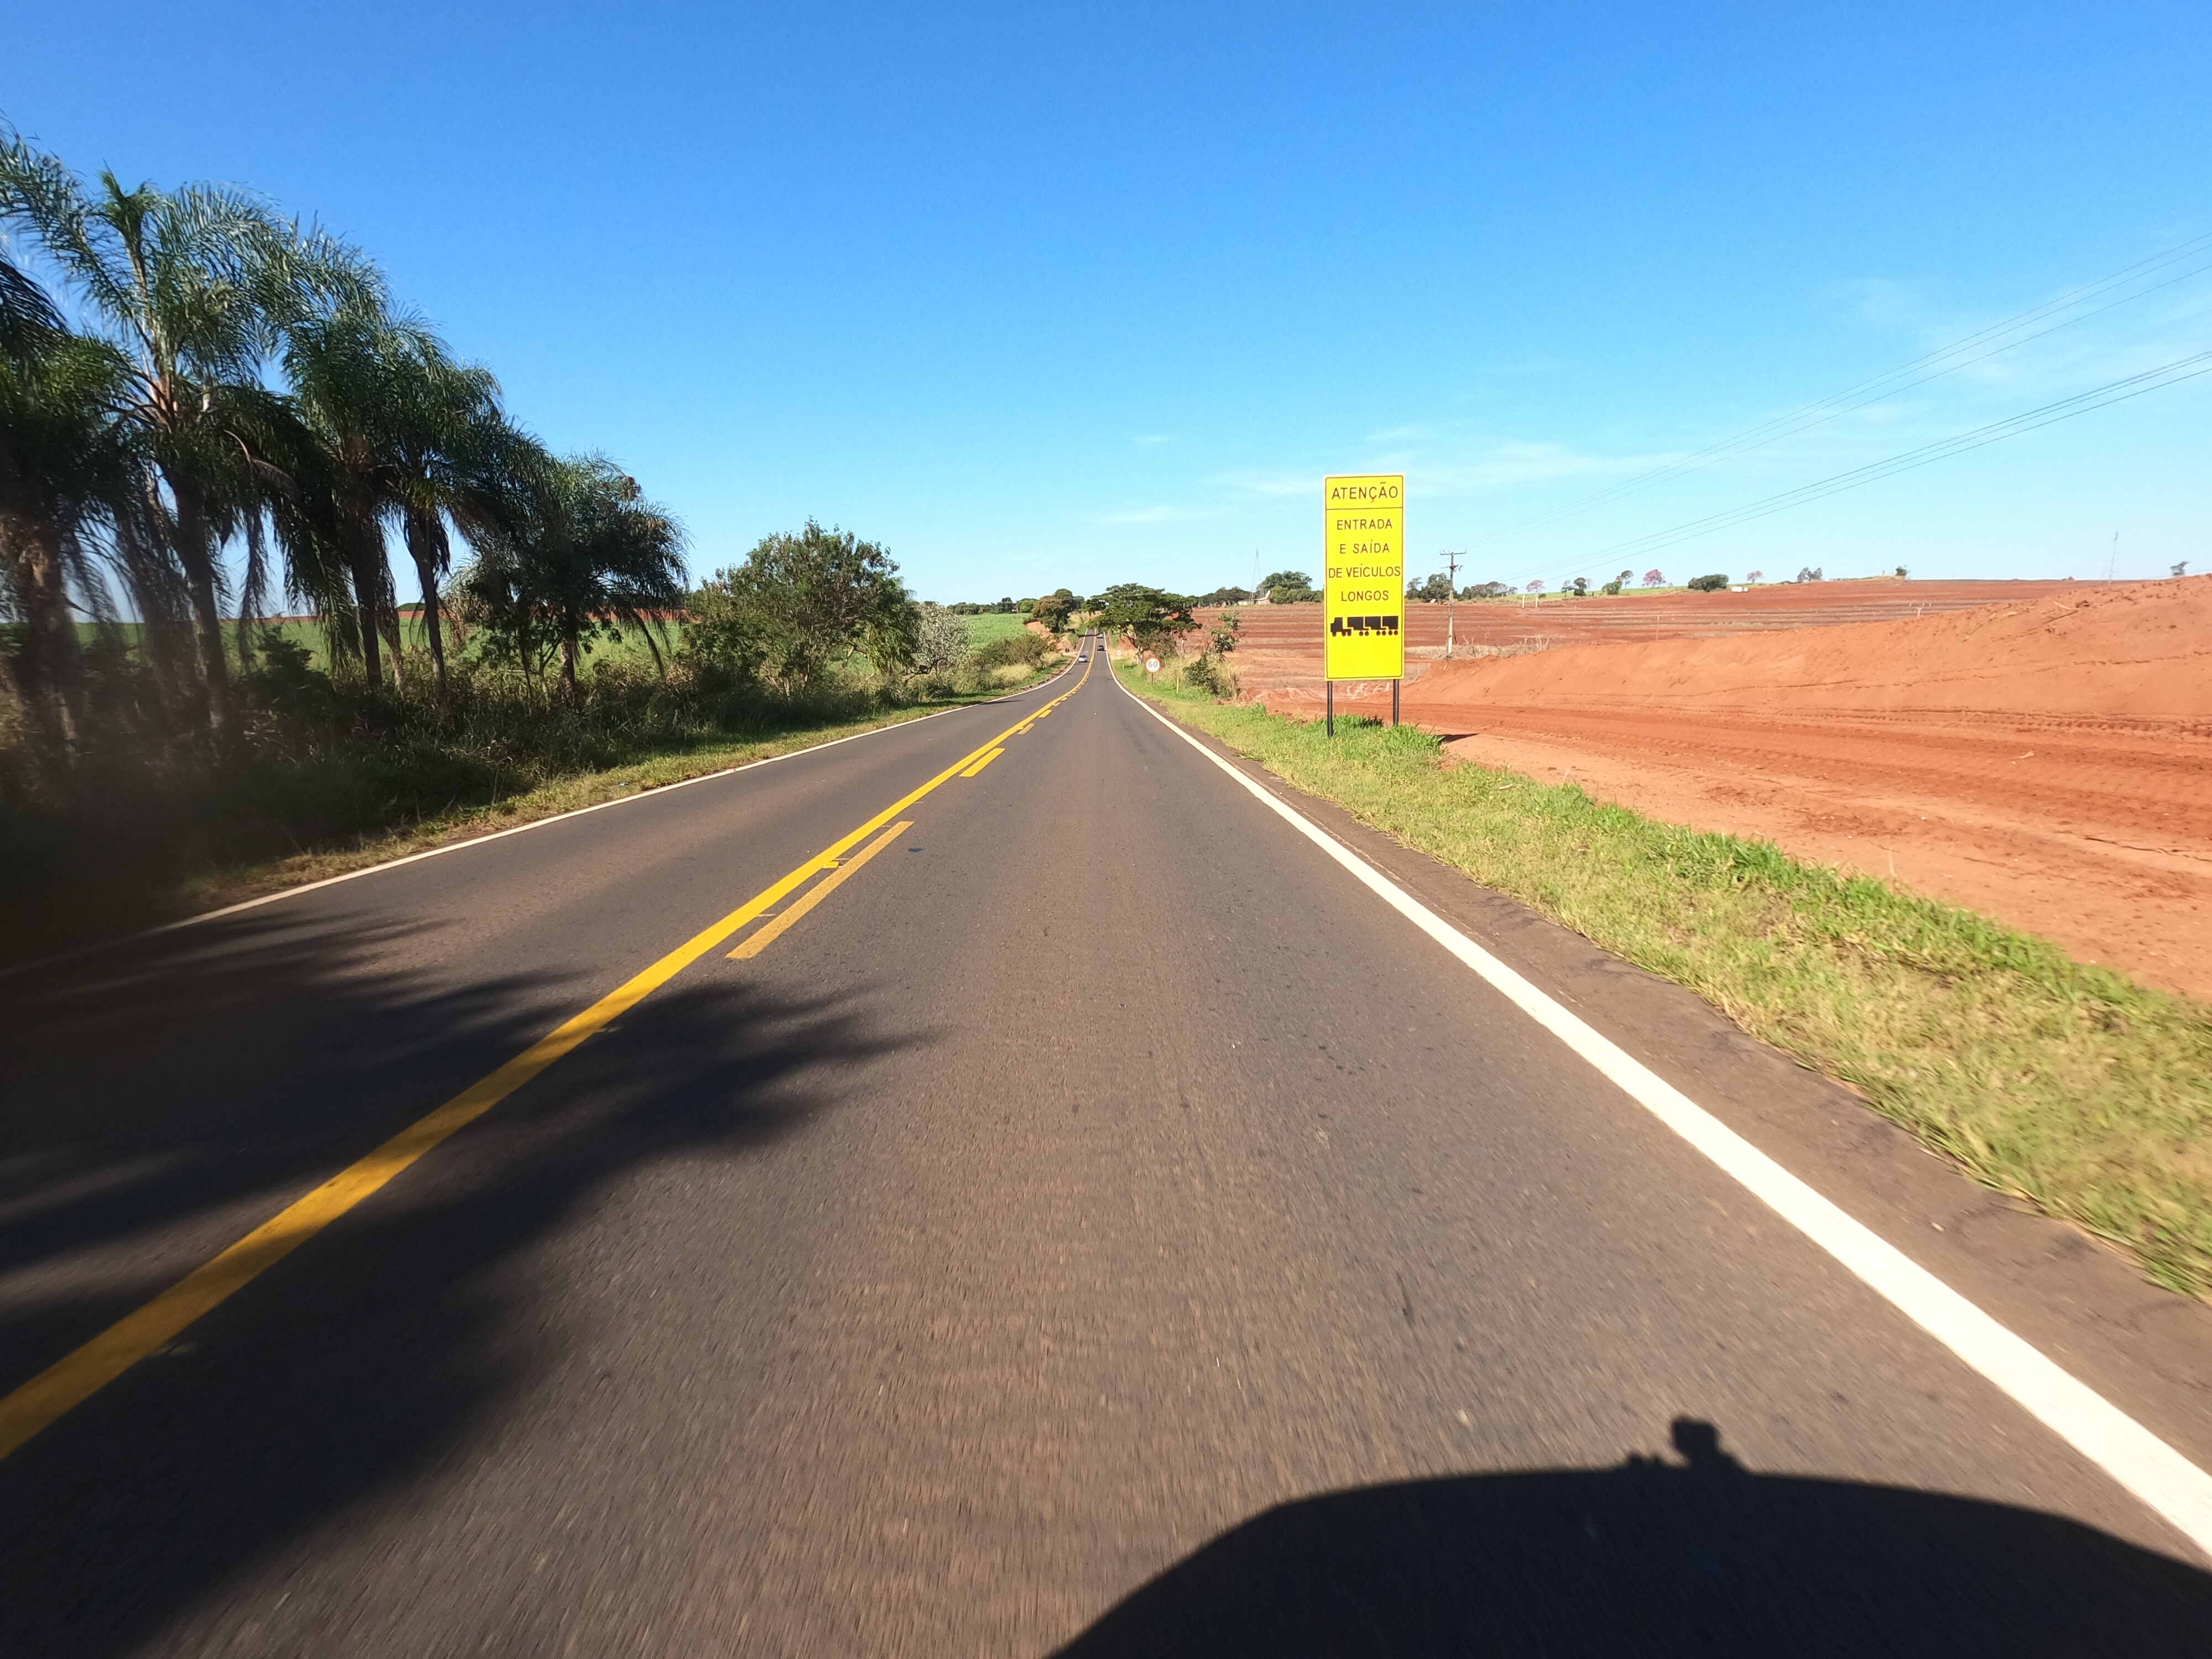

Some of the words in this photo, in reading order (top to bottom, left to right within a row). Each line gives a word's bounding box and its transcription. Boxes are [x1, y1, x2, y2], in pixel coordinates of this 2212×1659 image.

[1332, 482, 1398, 503] ATENÇÃO
[1337, 519, 1392, 530] ENTRADA
[1340, 544, 1346, 554] E
[1353, 539, 1390, 554] SAÍDA
[1328, 567, 1343, 578] DE
[1346, 563, 1401, 577] VEÍCULOS
[1341, 590, 1389, 602] LONGOS
